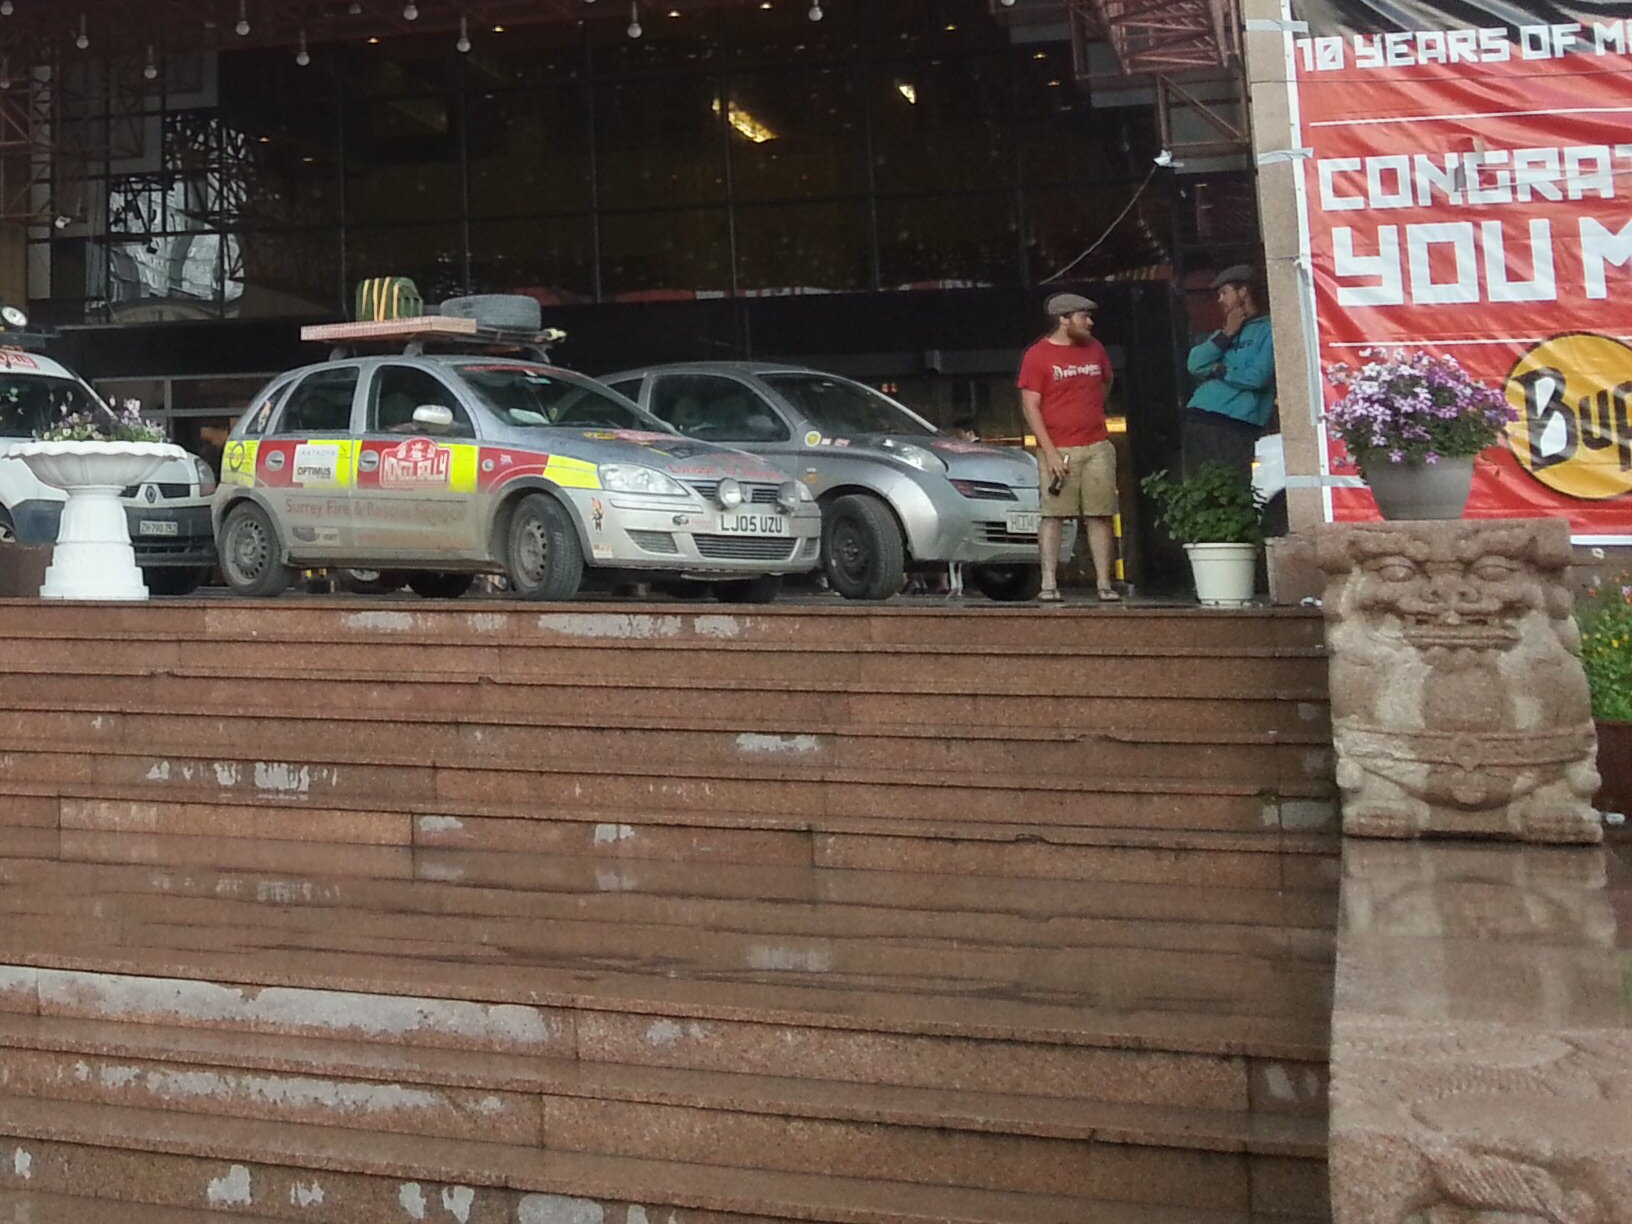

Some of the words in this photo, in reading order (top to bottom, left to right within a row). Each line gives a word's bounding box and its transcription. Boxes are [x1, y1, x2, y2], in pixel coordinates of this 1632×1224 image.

[1297, 36, 1345, 71] 10
[1353, 28, 1510, 68] YEARS
[1519, 23, 1581, 60] OF
[1593, 19, 1632, 56] M
[1331, 218, 1557, 306] YOU
[297, 466, 331, 476] OPTIMUS
[285, 499, 322, 517] Surrey
[326, 500, 350, 516] Fire
[721, 514, 757, 532] LJ05
[760, 516, 783, 533] UZU
